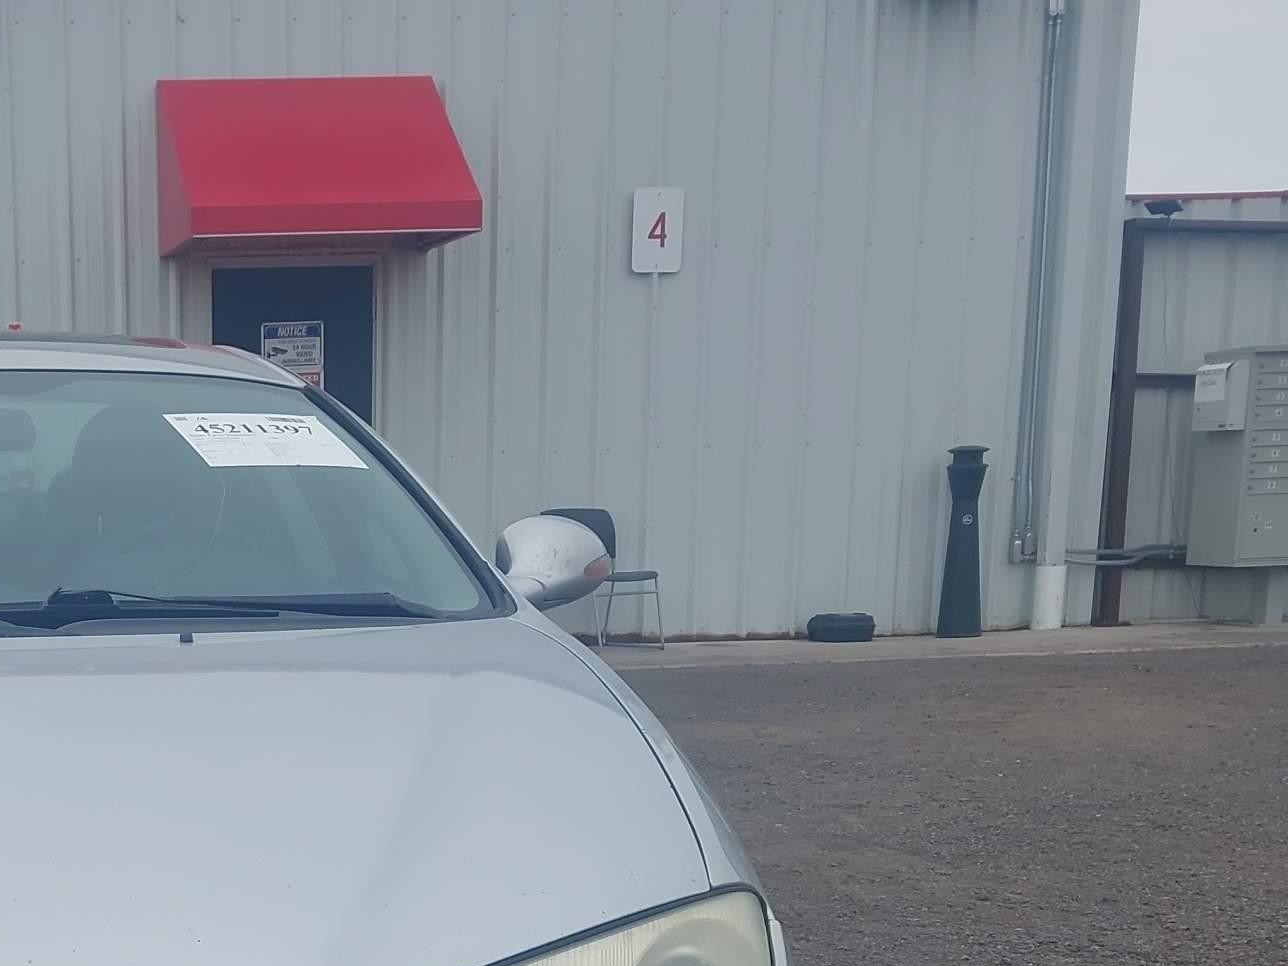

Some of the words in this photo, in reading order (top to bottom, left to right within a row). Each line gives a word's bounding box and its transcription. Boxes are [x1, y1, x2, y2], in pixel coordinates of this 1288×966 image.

[648, 211, 667, 248] 4
[277, 326, 307, 337] NOTICE
[194, 423, 313, 435] 45211397
